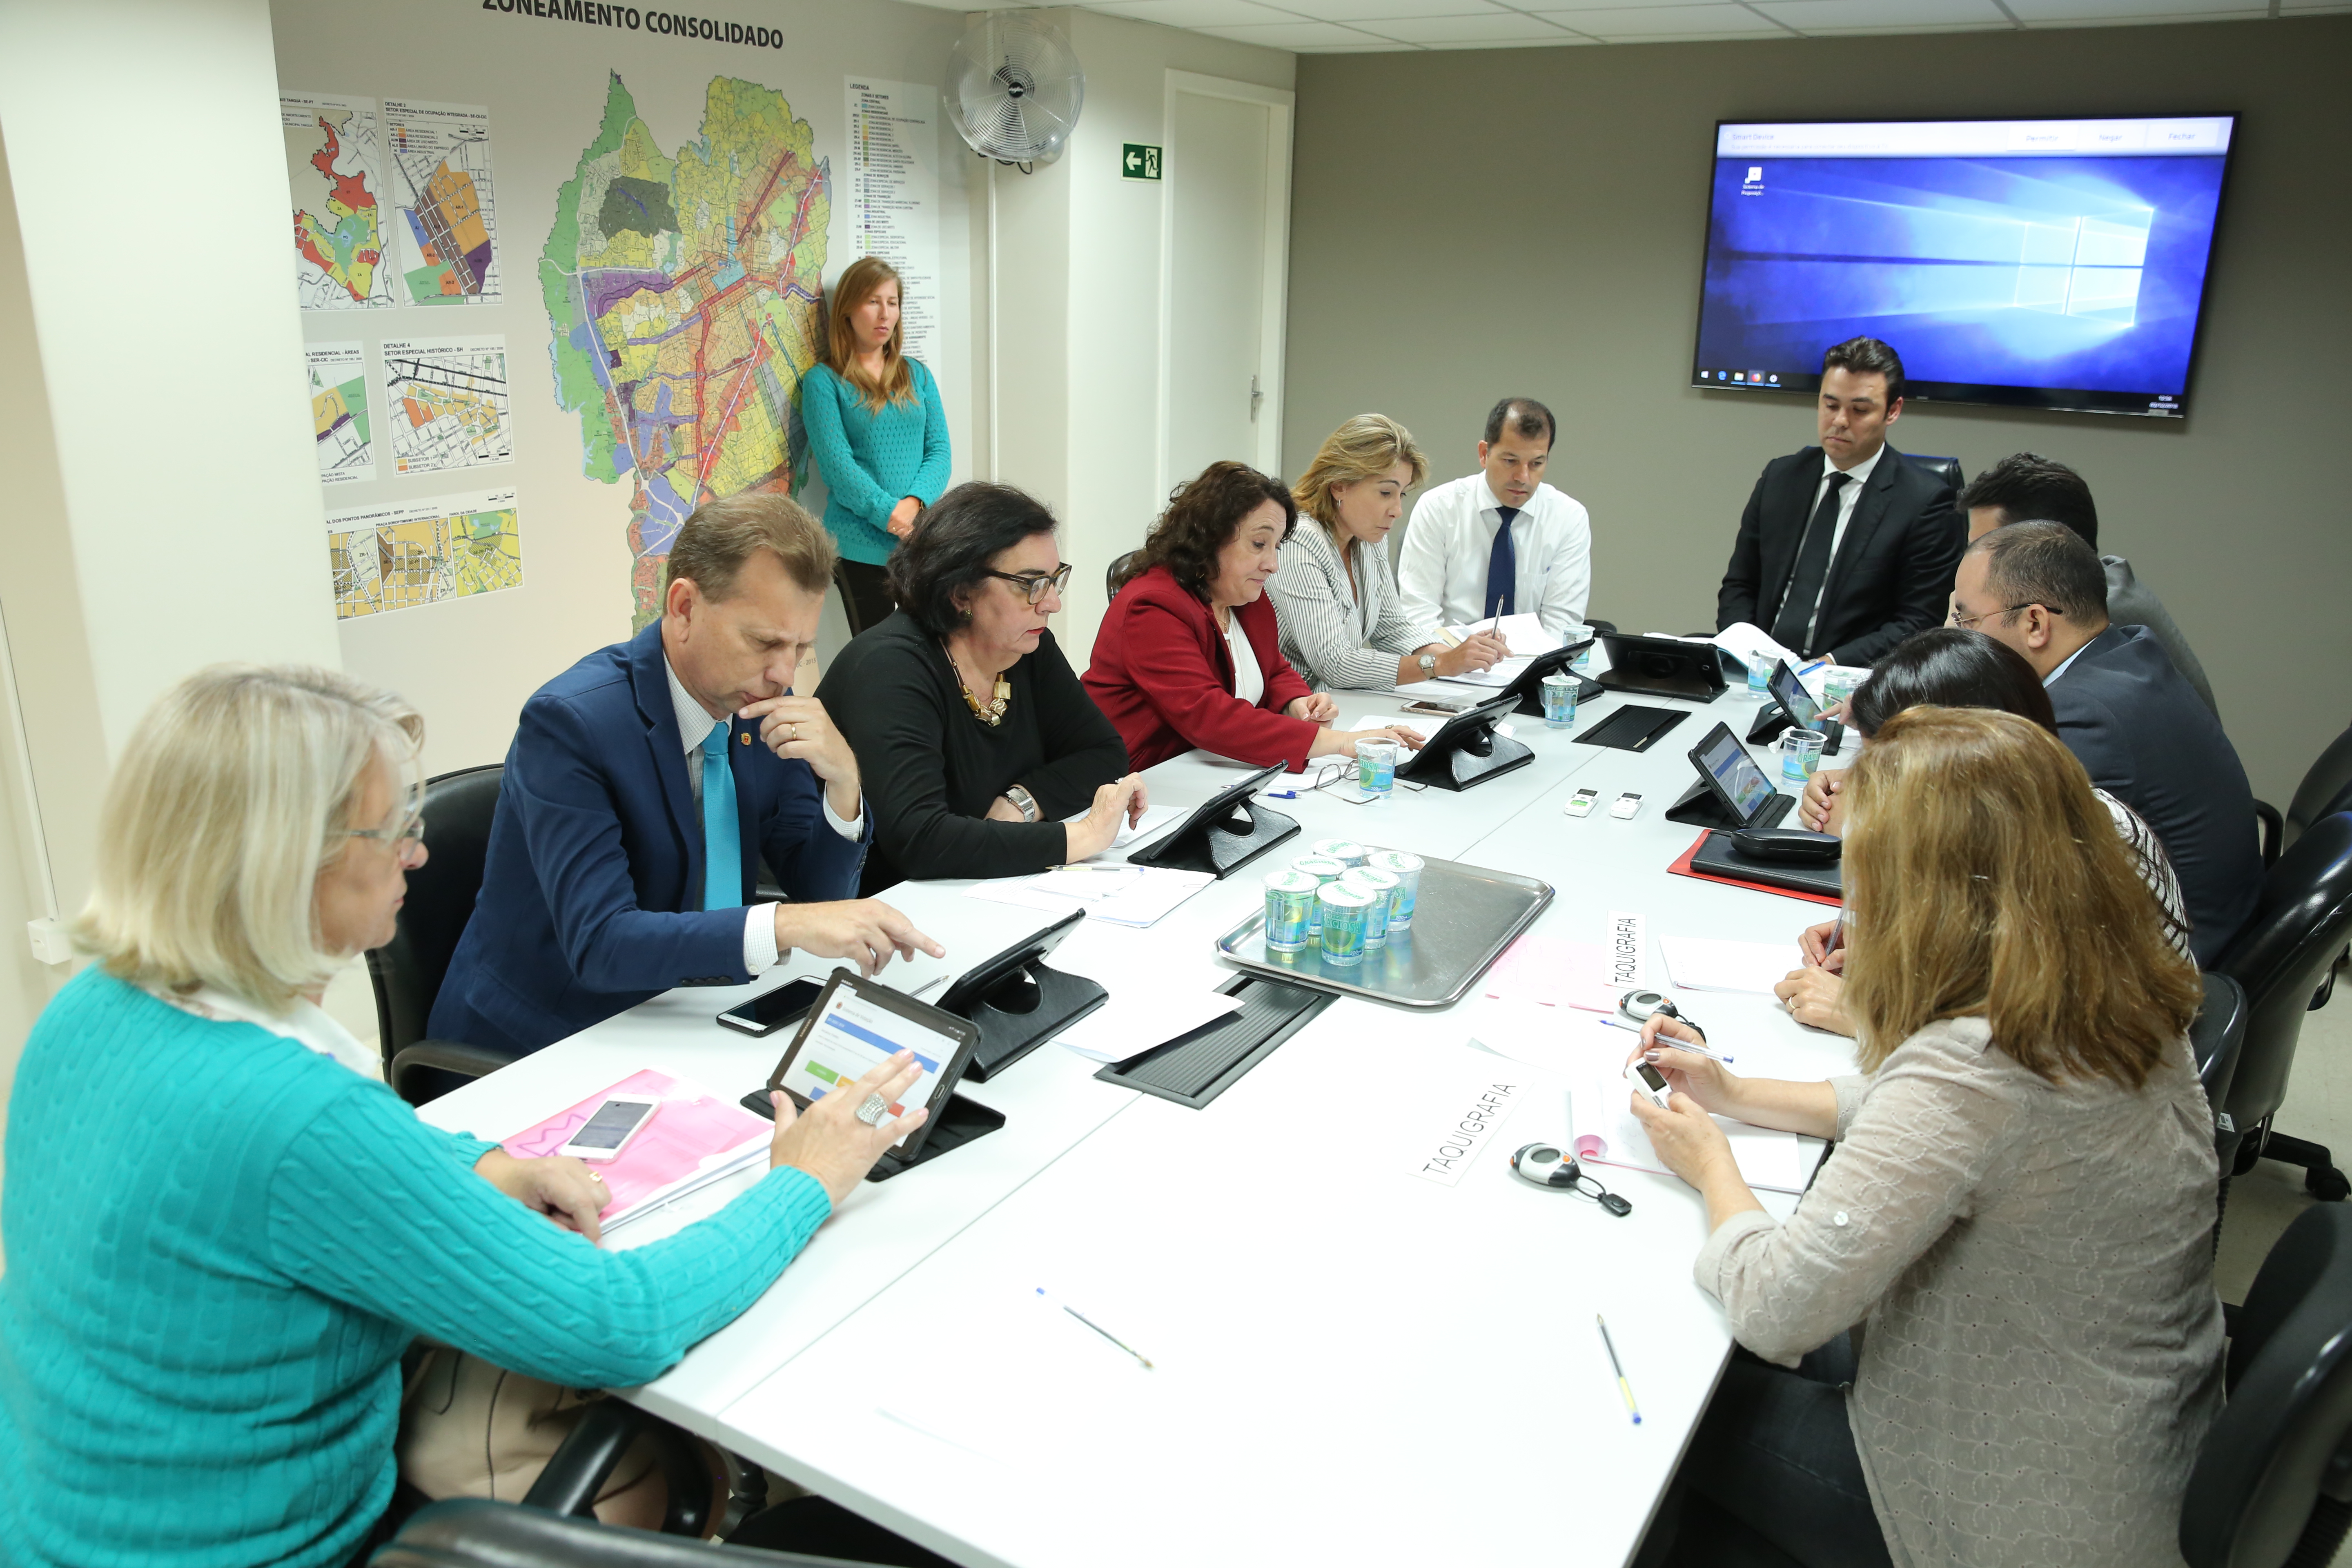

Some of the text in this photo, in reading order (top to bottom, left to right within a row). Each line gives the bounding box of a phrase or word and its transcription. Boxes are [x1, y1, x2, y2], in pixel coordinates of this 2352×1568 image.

[645, 11, 783, 49] CONSOLIDADO
[2026, 134, 2058, 143] Permitir
[2098, 134, 2123, 143] Negar
[2168, 132, 2196, 140] Fechar
[361, 511, 391, 520] PANORÂMICOS
[1333, 884, 1365, 900] GRACIOSA
[1615, 919, 1636, 982] TAQUIGRAFIA
[1423, 1084, 1517, 1174] TAQUIGRAFIA
